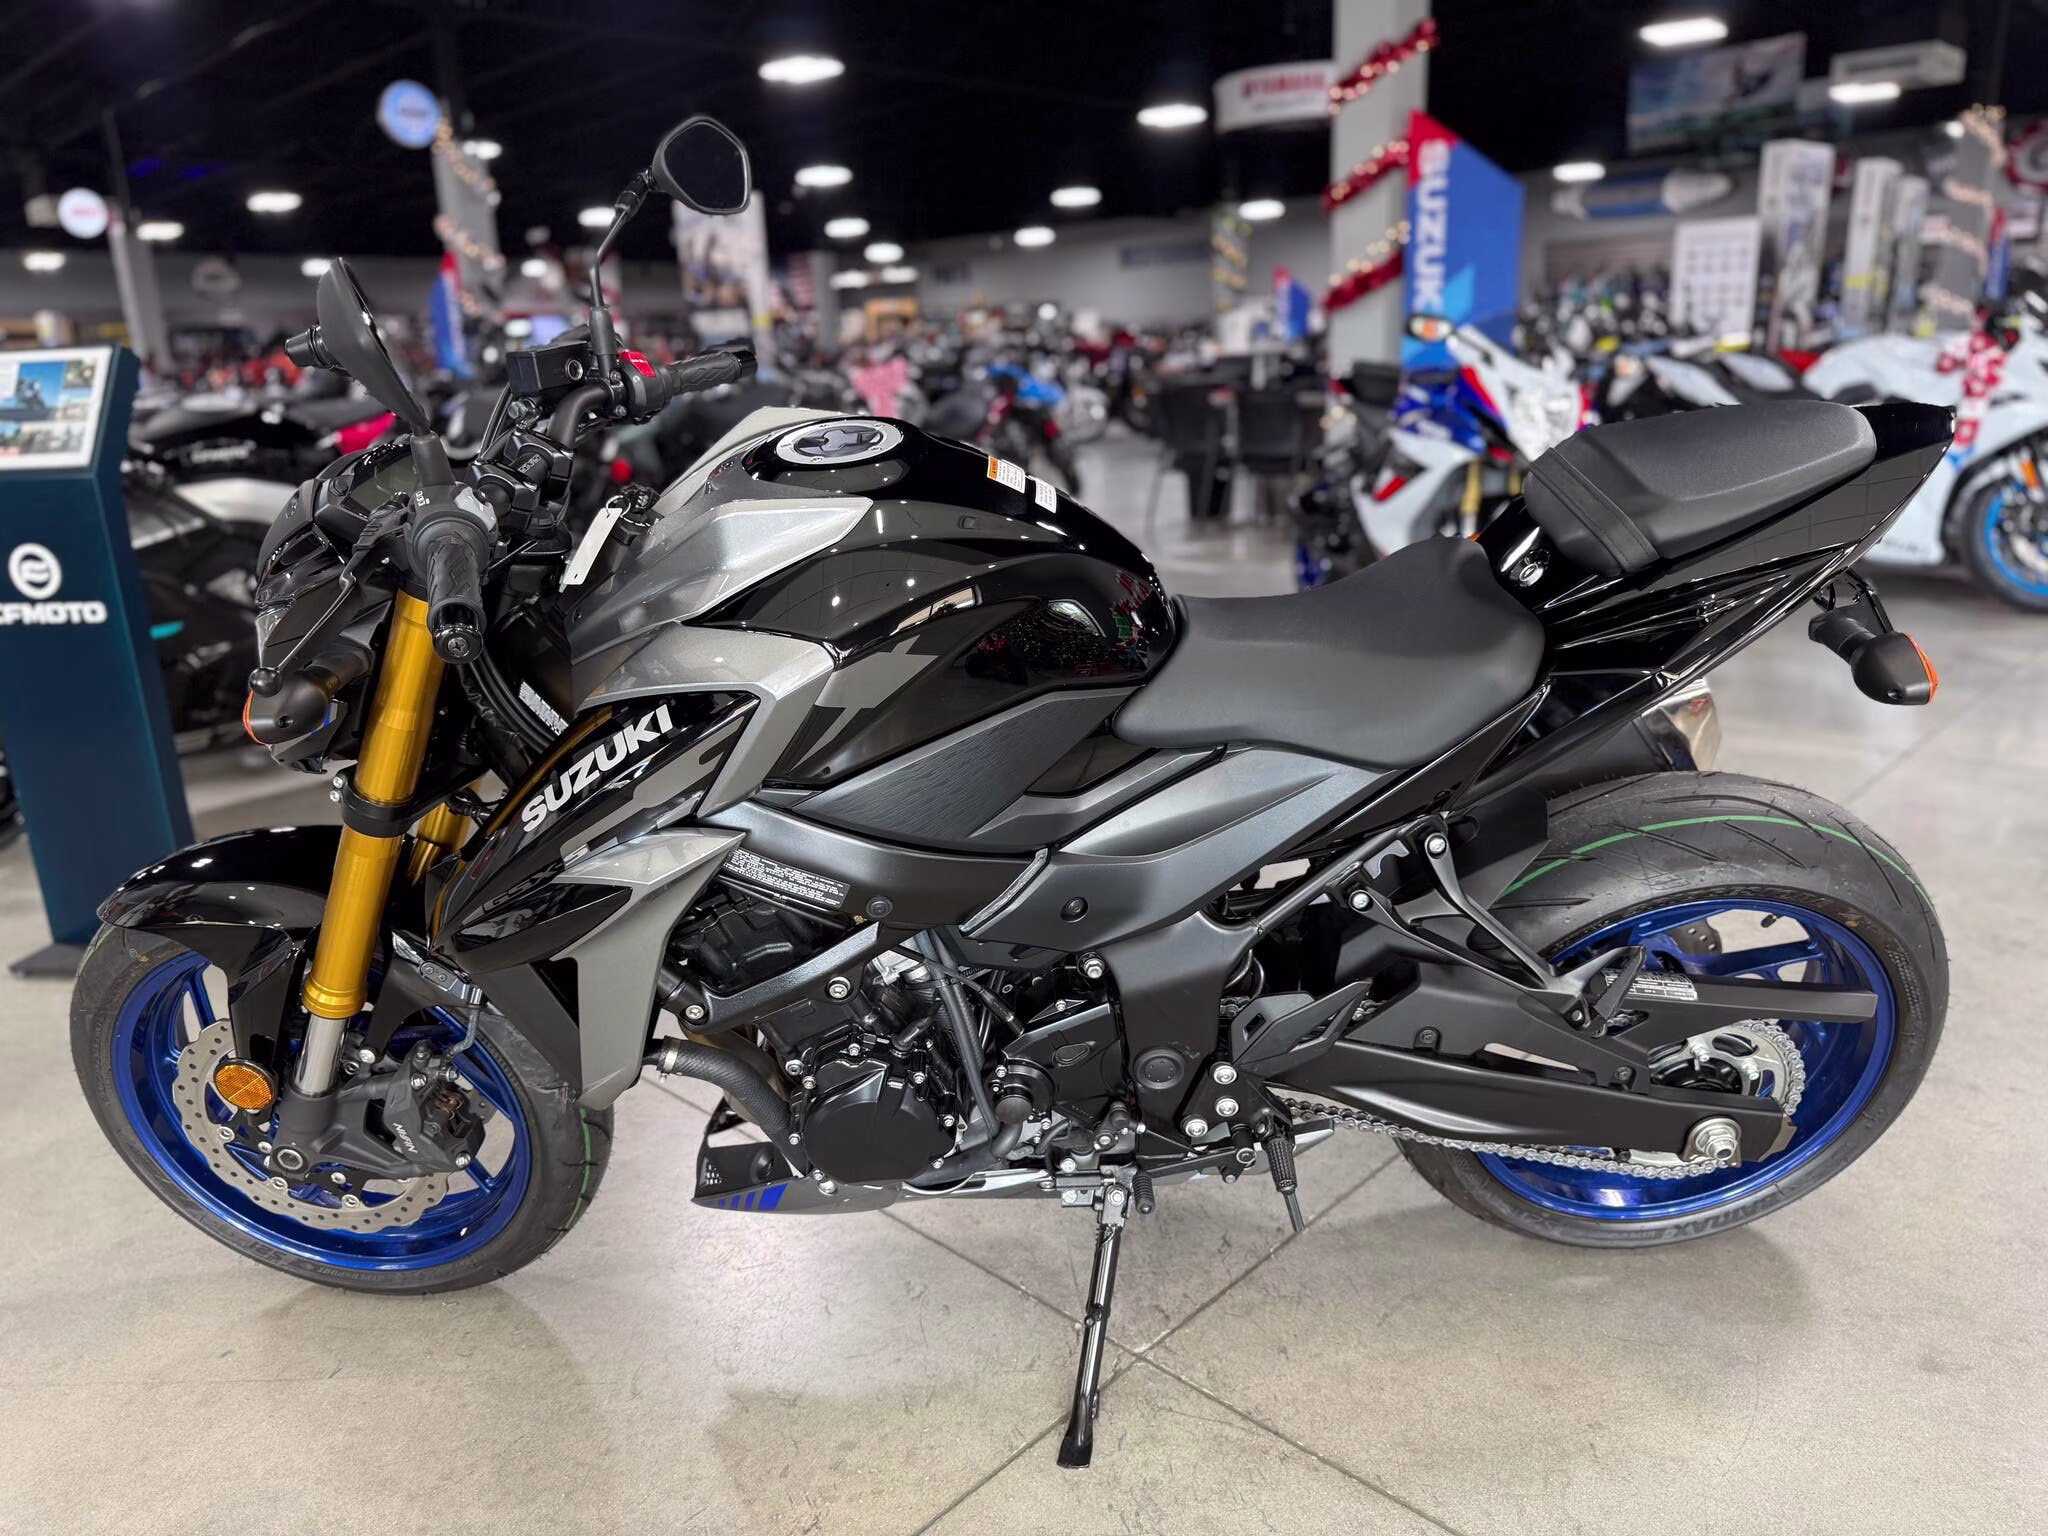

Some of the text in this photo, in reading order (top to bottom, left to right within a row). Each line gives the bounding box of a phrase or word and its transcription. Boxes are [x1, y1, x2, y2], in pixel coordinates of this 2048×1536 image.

[1413, 138, 1449, 314] SUZUK
[0, 600, 107, 625] FMOTO
[521, 704, 673, 832] SUZUKI
[483, 843, 588, 912] GSX-S
